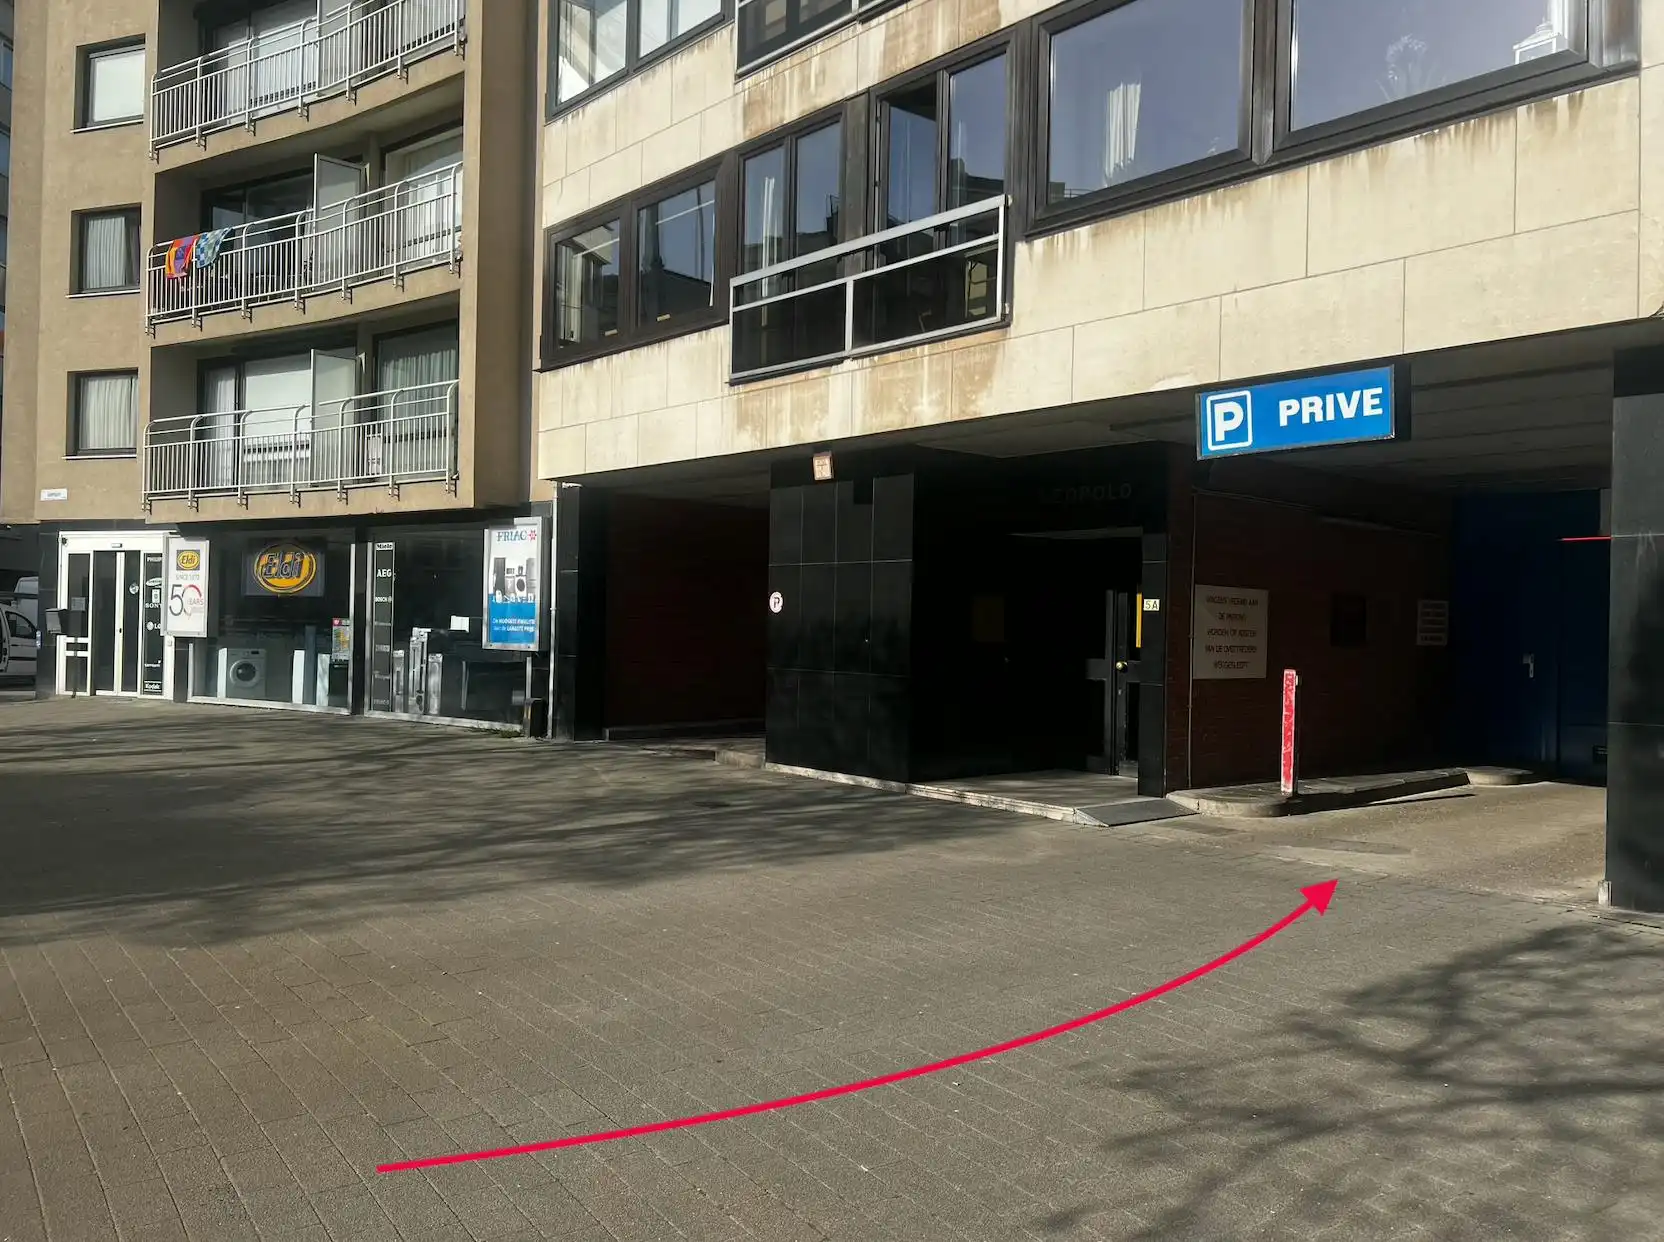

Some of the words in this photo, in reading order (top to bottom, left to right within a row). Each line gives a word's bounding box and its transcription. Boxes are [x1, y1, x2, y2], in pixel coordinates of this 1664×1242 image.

[1213, 400, 1244, 442] P
[1278, 387, 1384, 427] PRIVE
[497, 530, 527, 542] FRIAC
[181, 555, 195, 564] Eldi
[264, 551, 303, 578] Eldi
[377, 569, 392, 578] AEG
[1145, 600, 1159, 610] 5A
